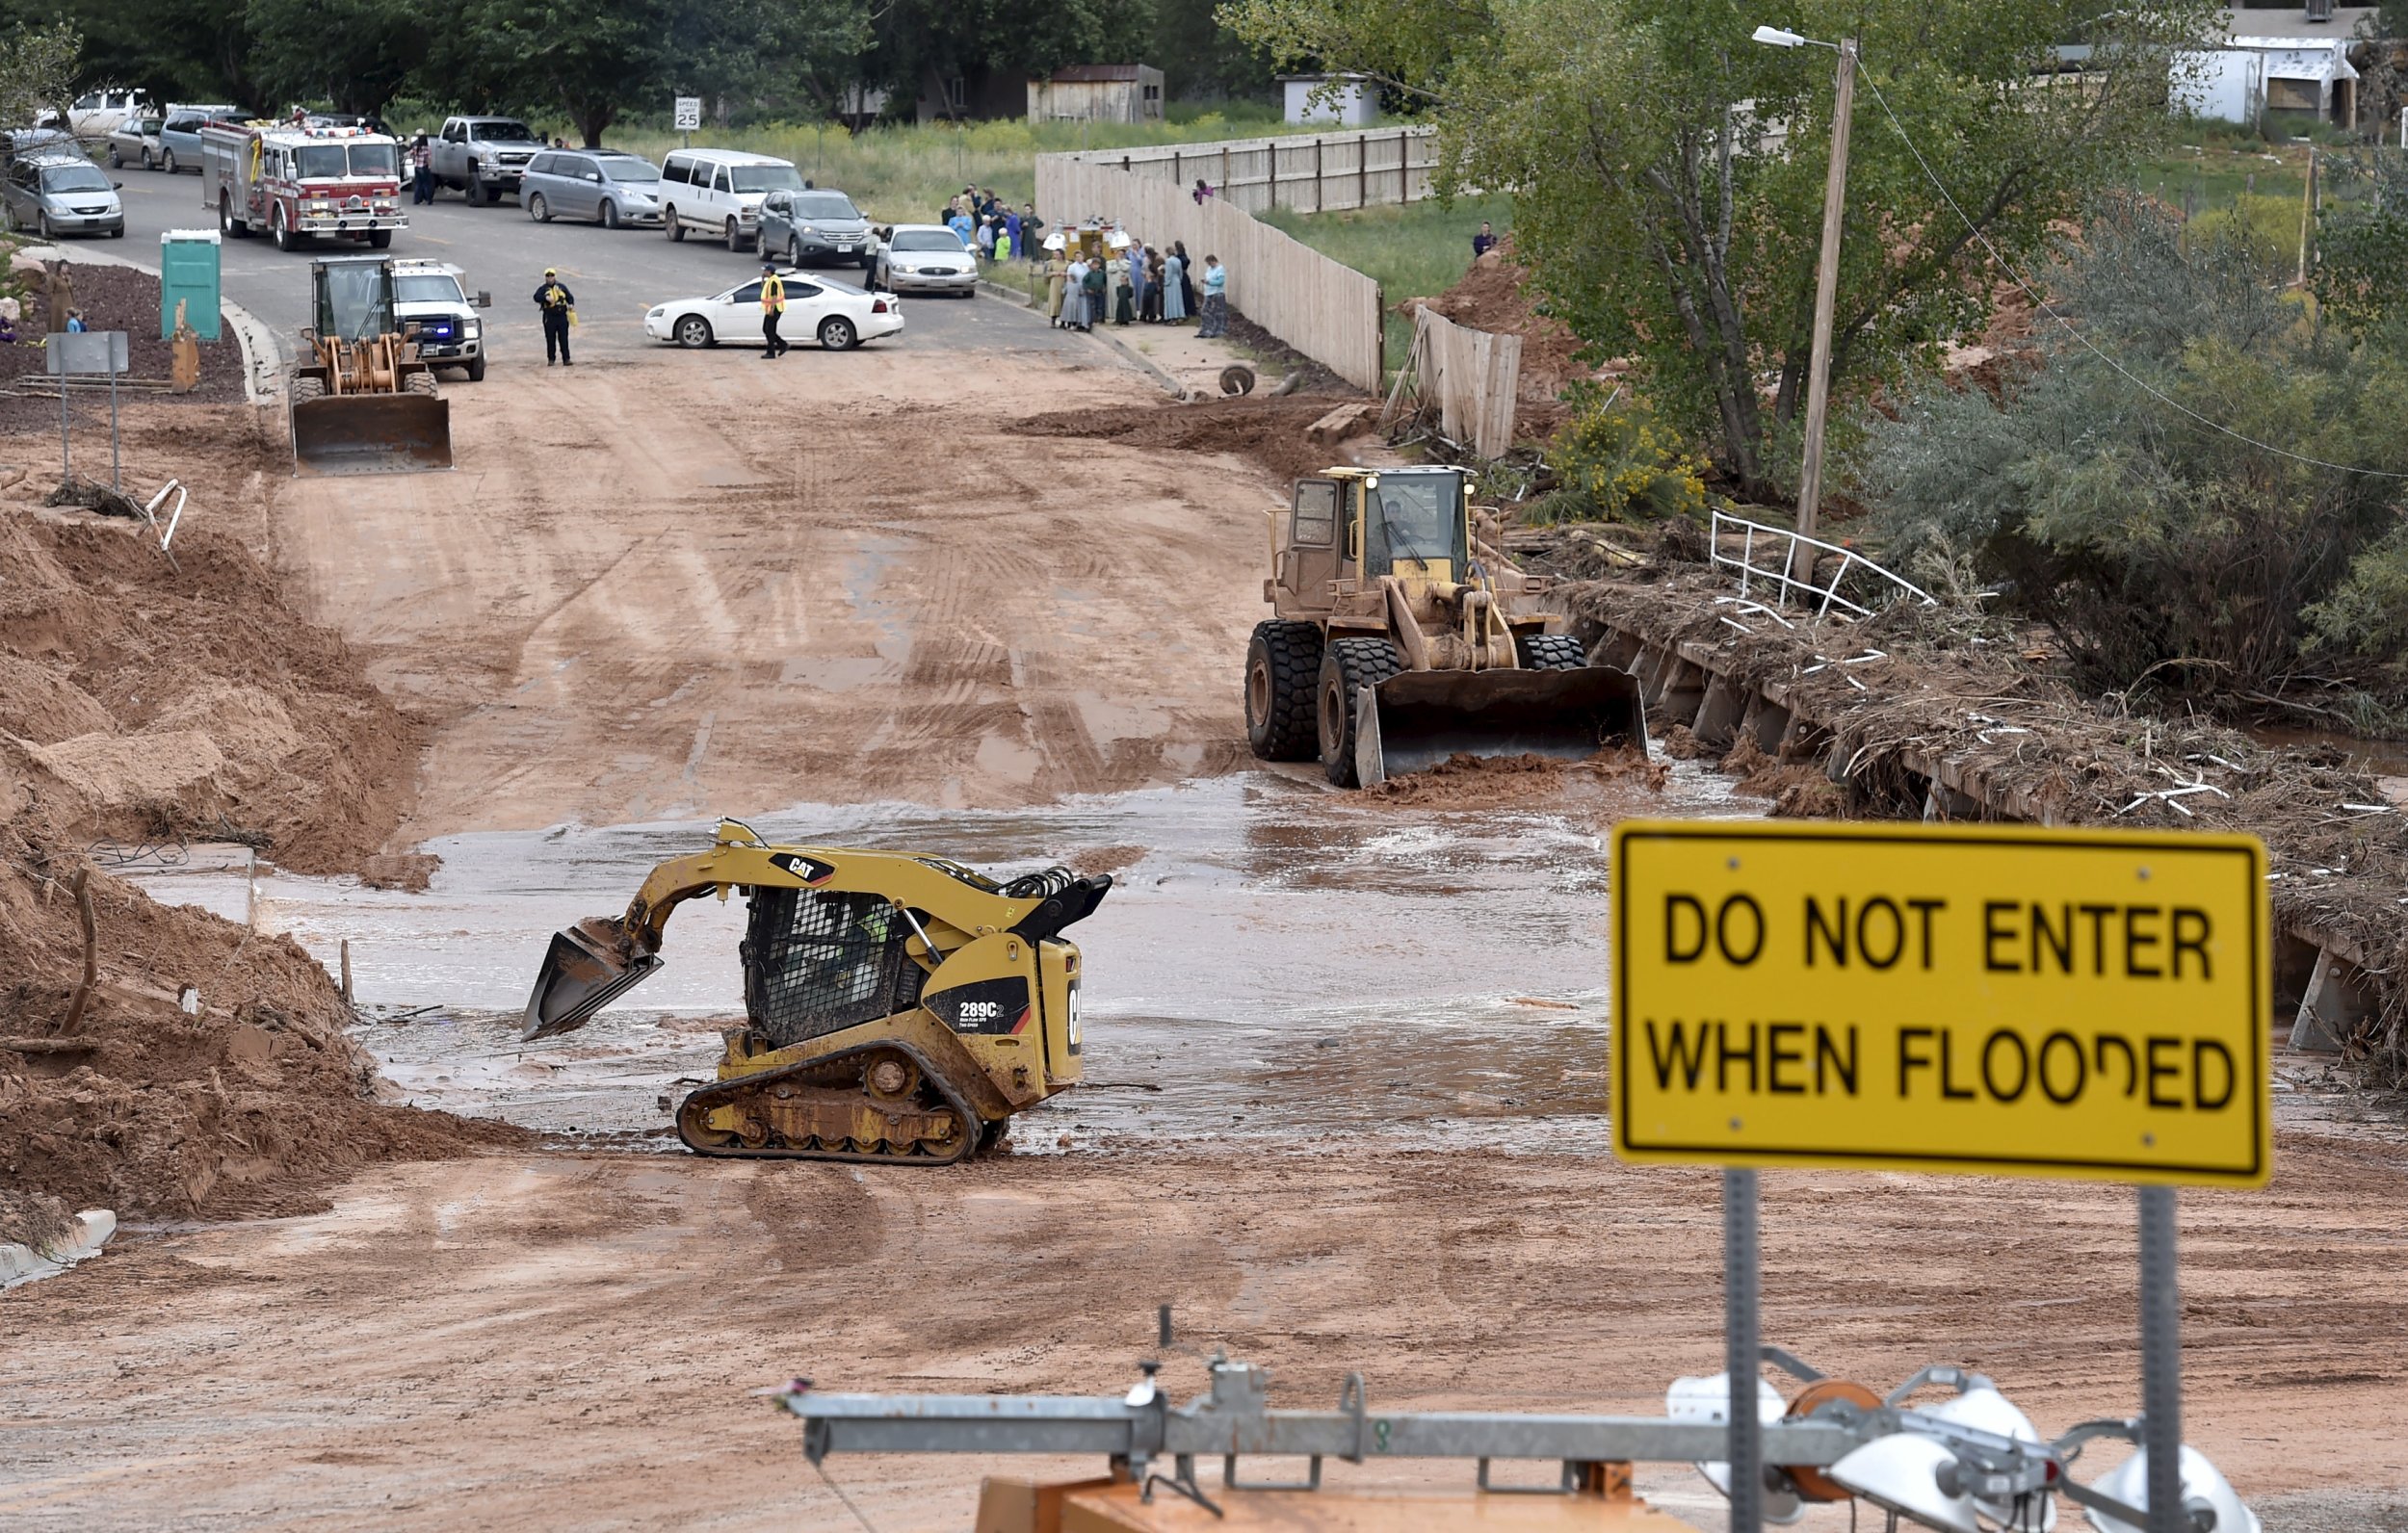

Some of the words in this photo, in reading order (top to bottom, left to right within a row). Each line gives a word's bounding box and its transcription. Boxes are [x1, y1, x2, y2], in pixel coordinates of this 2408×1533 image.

[678, 115, 697, 125] 25
[789, 858, 814, 878] CAT
[1663, 892, 1767, 969] DO
[1804, 895, 1948, 972] NOT
[1982, 899, 2212, 981] ENTER
[1644, 1019, 1859, 1098] WHEN
[1898, 1026, 2238, 1113] FLOODED
